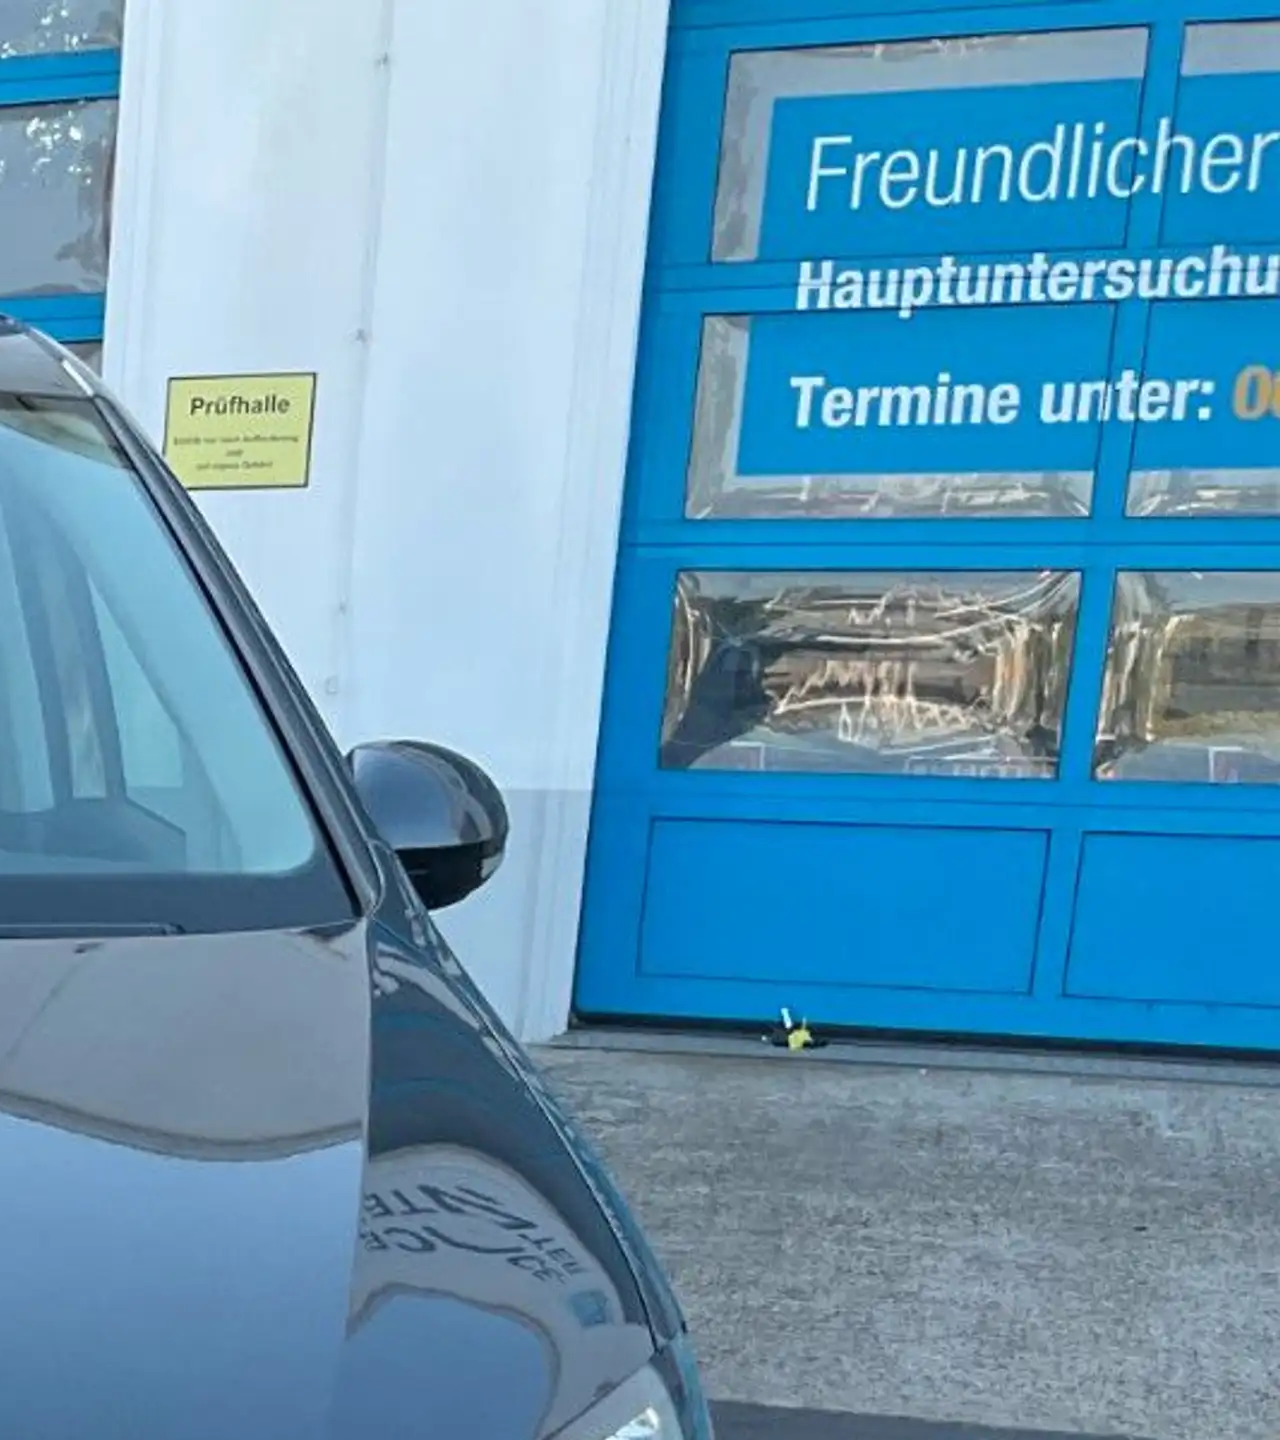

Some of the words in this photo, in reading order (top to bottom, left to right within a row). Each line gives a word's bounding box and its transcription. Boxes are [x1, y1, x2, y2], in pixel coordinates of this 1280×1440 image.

[805, 117, 1280, 211] Freundlicher
[796, 244, 1280, 319] Hauptuntersuchu
[190, 393, 292, 416] Prüfhalle
[790, 372, 1018, 429] Termine
[1040, 368, 1215, 424] unter:
[1232, 364, 1280, 421] 0
